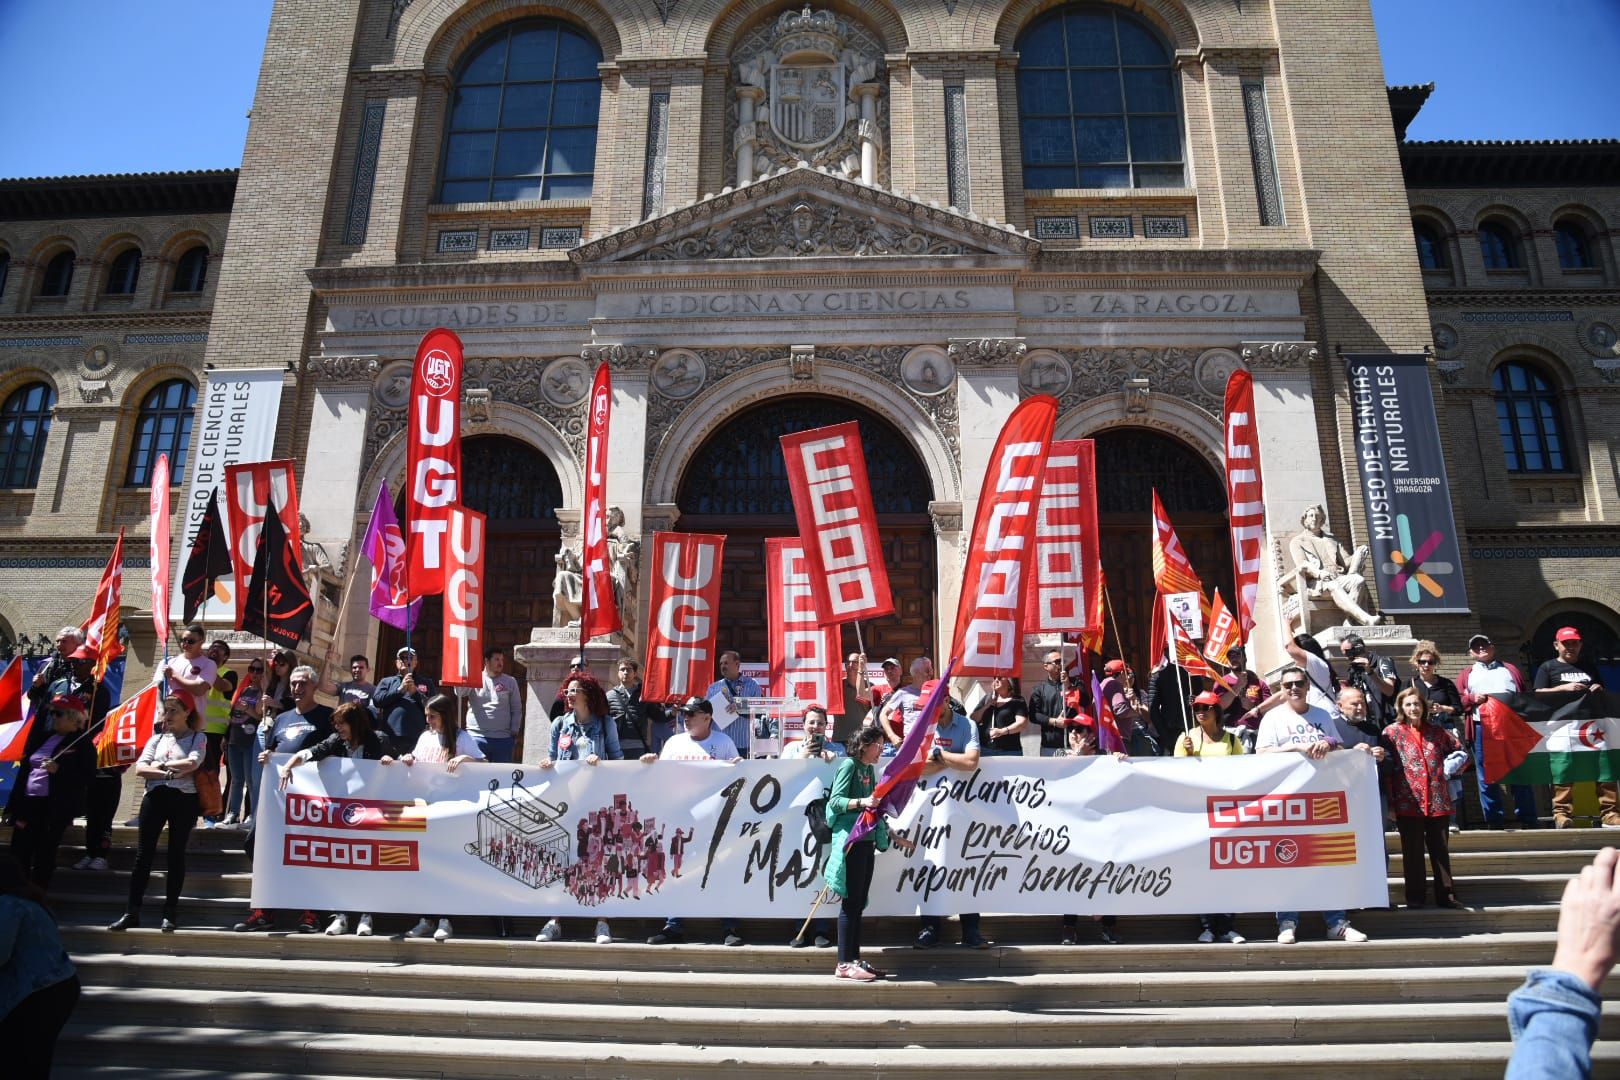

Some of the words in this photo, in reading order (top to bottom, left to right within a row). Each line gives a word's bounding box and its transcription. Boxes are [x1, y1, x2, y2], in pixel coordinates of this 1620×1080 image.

[352, 304, 519, 329] FACULTADES
[532, 303, 568, 324] DE
[636, 294, 784, 316] MEDICINA
[791, 293, 814, 313] Y
[822, 290, 971, 313] CIENCIAS
[1043, 294, 1077, 314] DE
[1089, 294, 1262, 314] ZARAGOZA
[201, 380, 228, 457] CIENCIAS
[1351, 365, 1379, 445] CIENCIAS
[1376, 365, 1410, 472] NATURALES
[220, 380, 251, 482] ATURALES
[196, 462, 215, 484] DE
[1362, 449, 1384, 473] DE
[411, 394, 457, 569] UGT
[1393, 477, 1441, 486] UNIVERSIDAD
[1395, 485, 1433, 494] ZARAGOZA
[1367, 478, 1394, 541] MUSEO
[800, 435, 877, 616] CCOO
[963, 441, 1042, 670] CCOO
[447, 509, 482, 677] UGT
[655, 541, 716, 696] UGT
[1287, 721, 1326, 737] LOOK
[289, 797, 341, 825] UGT
[1212, 798, 1307, 824] CCOO
[739, 820, 763, 838] DE
[960, 820, 1071, 859] precios
[289, 839, 372, 866] CCOO
[1214, 840, 1272, 865] UGT
[895, 850, 1023, 903] repartir
[1019, 853, 1172, 900] beneficios
